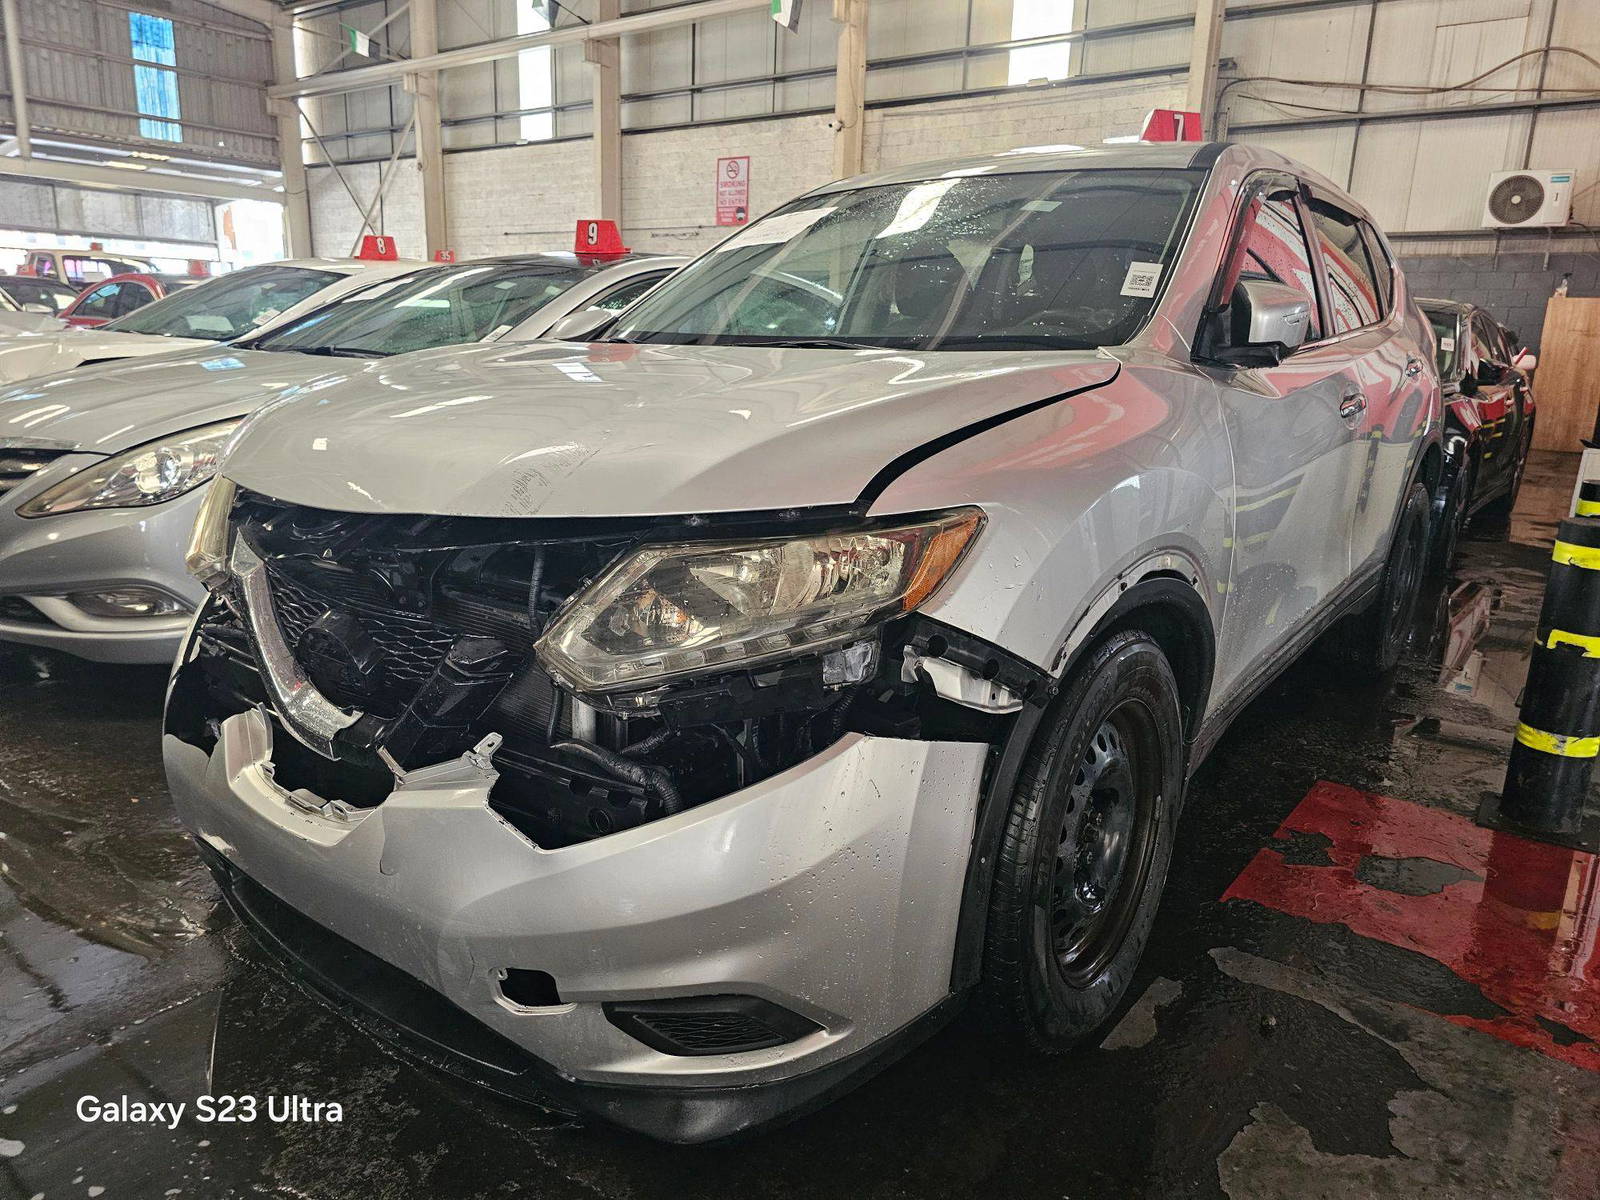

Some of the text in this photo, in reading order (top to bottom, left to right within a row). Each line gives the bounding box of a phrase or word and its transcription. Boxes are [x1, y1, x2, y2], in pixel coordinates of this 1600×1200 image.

[1173, 114, 1185, 142] 7
[588, 222, 598, 245] 9
[376, 237, 386, 254] 8
